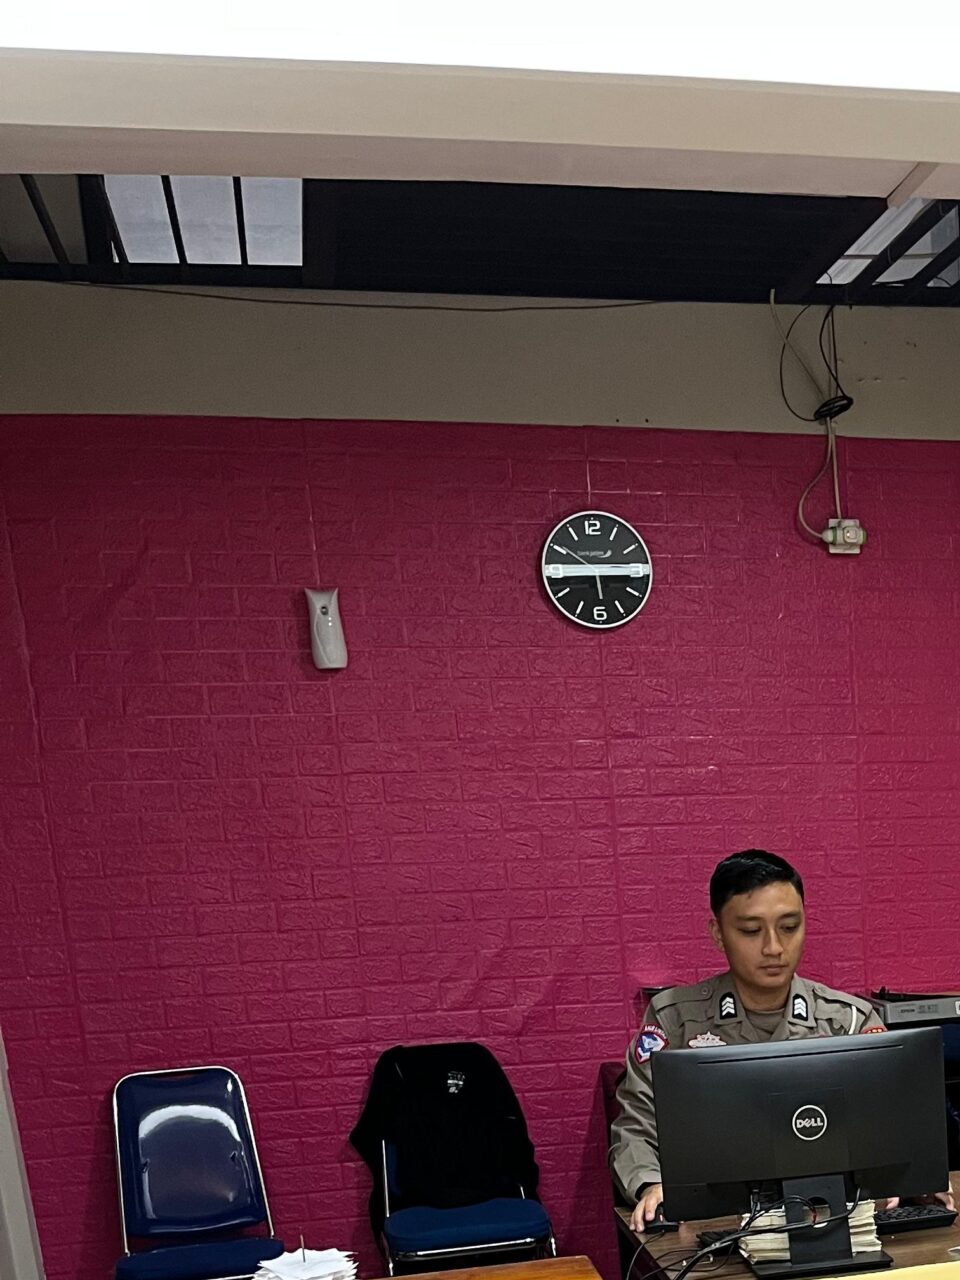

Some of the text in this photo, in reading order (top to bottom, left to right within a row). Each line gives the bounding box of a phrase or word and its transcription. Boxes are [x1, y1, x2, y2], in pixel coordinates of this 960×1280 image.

[584, 520, 602, 535] 12
[593, 606, 608, 621] 6
[796, 1117, 824, 1129] DELL
